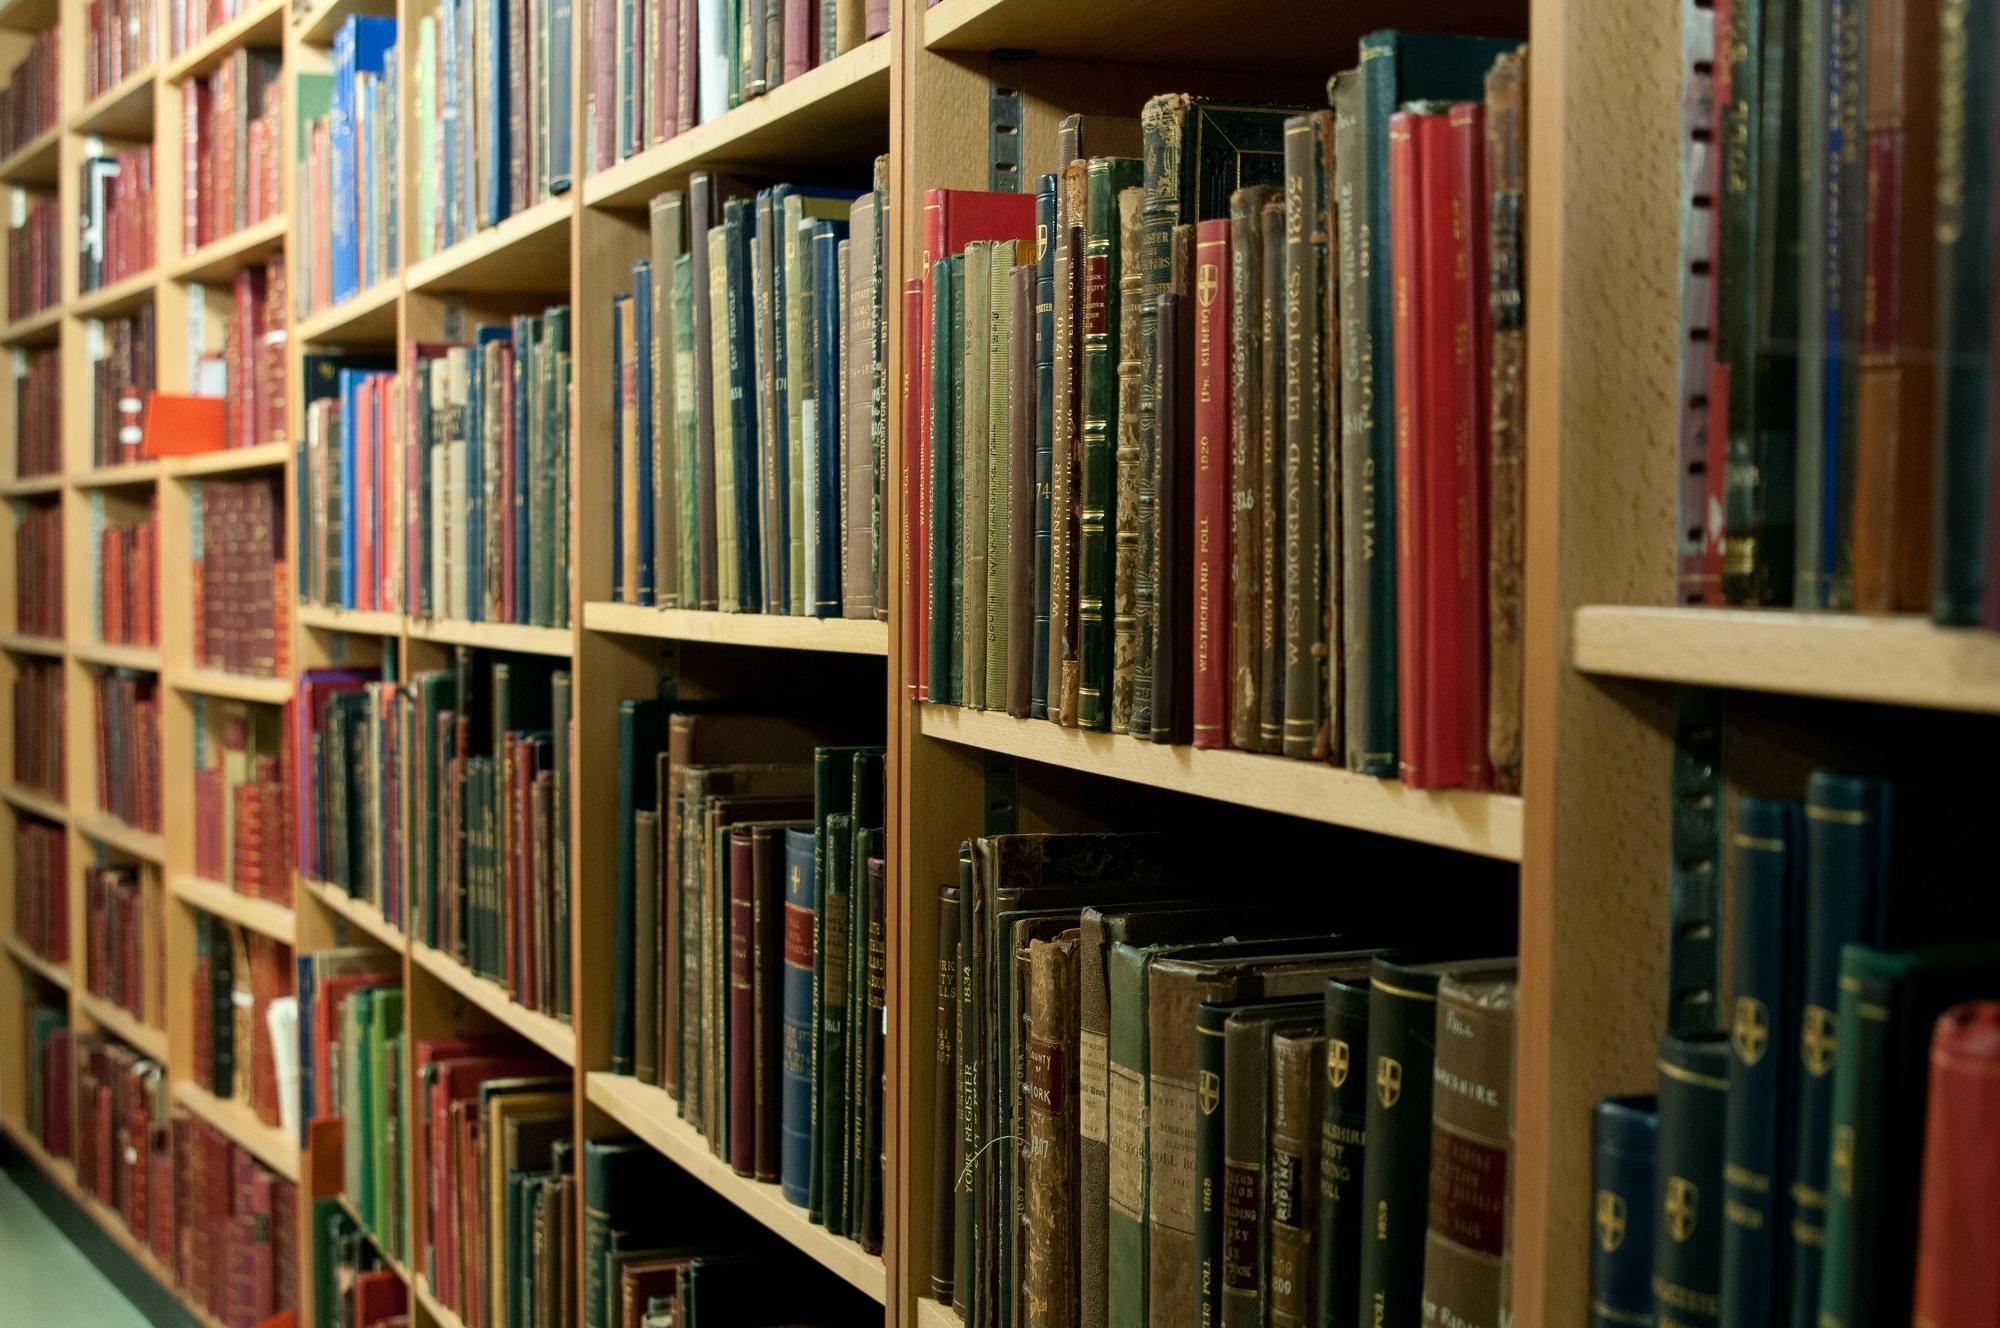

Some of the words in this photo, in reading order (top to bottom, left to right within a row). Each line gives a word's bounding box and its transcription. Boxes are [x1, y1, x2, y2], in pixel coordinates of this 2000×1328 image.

[1287, 176, 1303, 245] 1832
[1340, 182, 1356, 288] WILTSHIRE
[729, 289, 737, 339] NORFOLK
[1055, 310, 1065, 362] 1780.
[1234, 251, 1246, 389] WESTMORLAND
[1287, 264, 1302, 421] ELECTORS.
[1068, 344, 1074, 358] OF
[1054, 379, 1063, 442] POLL.
[1199, 435, 1210, 472] 1820
[840, 457, 848, 587] NORTHAMPTON
[964, 471, 972, 581] WARWICKSHIRE
[1052, 462, 1062, 619] WESTMINSTER
[1200, 515, 1210, 554] POLL
[1287, 443, 1301, 666] WESTMORLAND
[1152, 497, 1161, 650] WESTMORLAND
[1263, 484, 1273, 650] WESTMORLAND
[988, 595, 997, 642] SOUTH
[1199, 561, 1210, 672] WESTMORLAND
[963, 965, 973, 1004] 1834
[811, 975, 820, 1127] NORTHUMBERLAND
[964, 1064, 973, 1143] REGISTER
[1016, 1115, 1024, 1147] CITY
[1017, 1094, 1024, 1106] OF
[964, 1152, 974, 1193] YORK
[1277, 1153, 1292, 1222] RIDING
[1202, 1257, 1212, 1295] POLL
